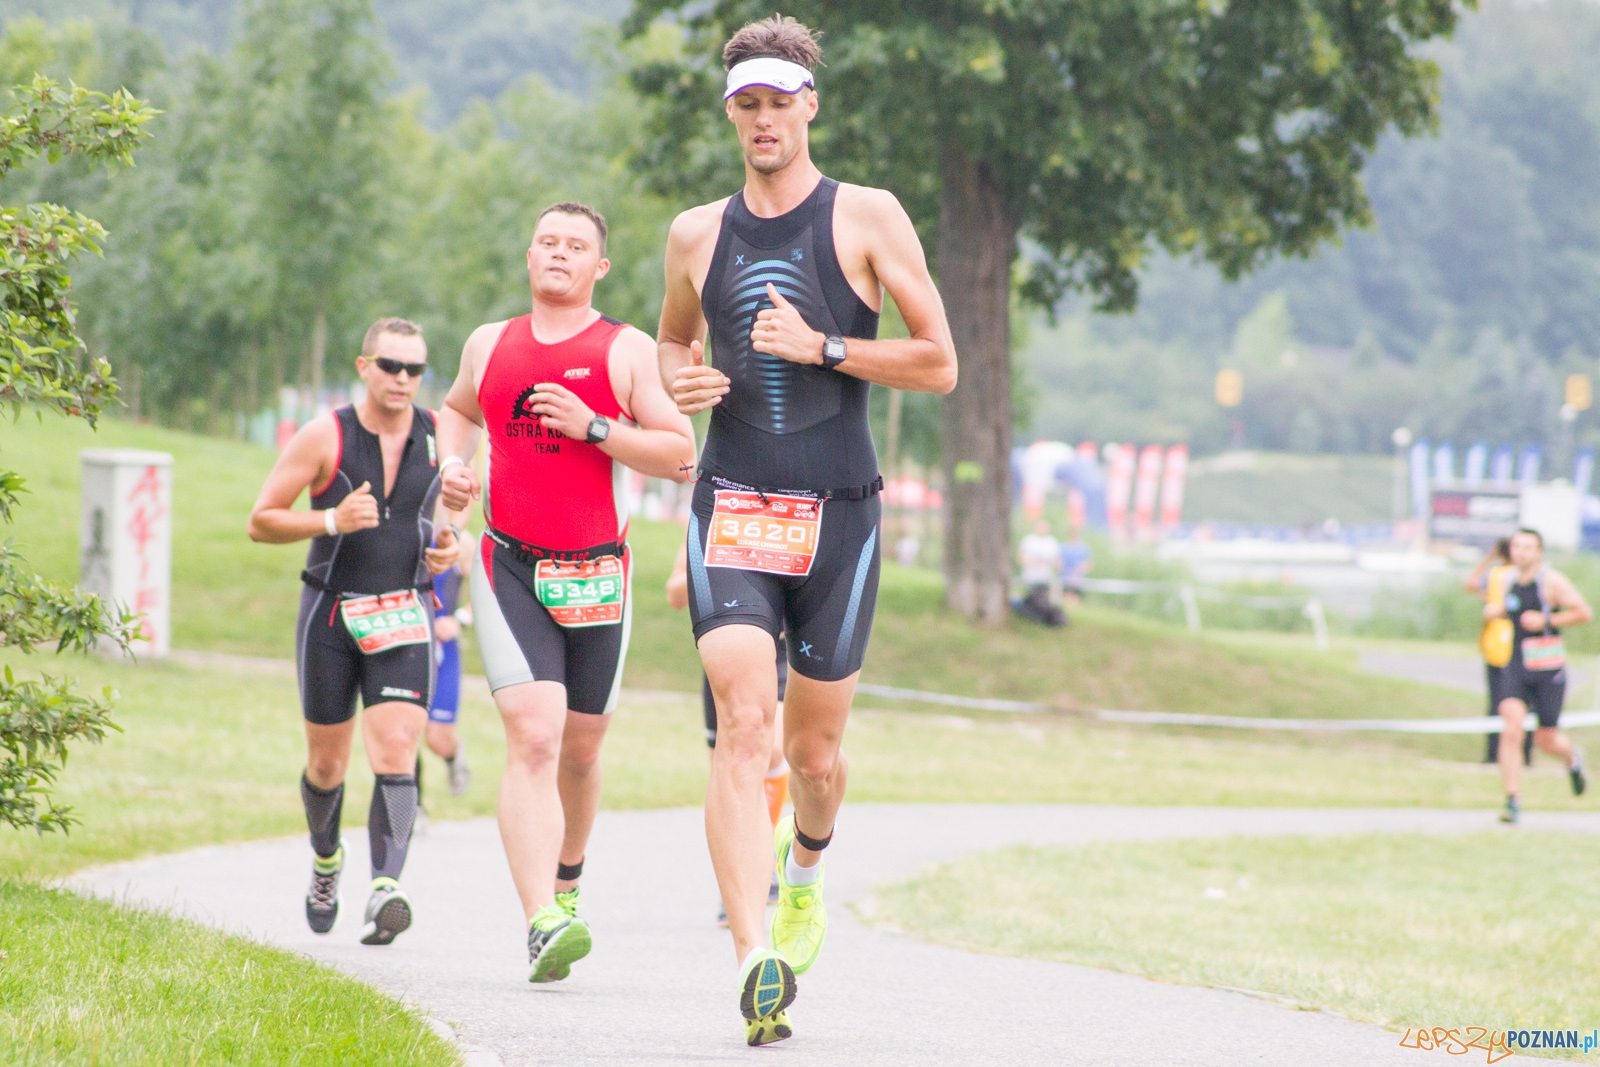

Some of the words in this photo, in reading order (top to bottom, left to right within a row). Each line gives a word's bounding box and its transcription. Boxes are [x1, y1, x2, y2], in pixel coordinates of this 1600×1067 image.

[563, 367, 591, 378] ATEX
[505, 423, 543, 438] OSTRA
[534, 443, 560, 454] TEAM
[711, 475, 755, 491] performance
[721, 519, 806, 543] 3620
[547, 580, 615, 598] 3348
